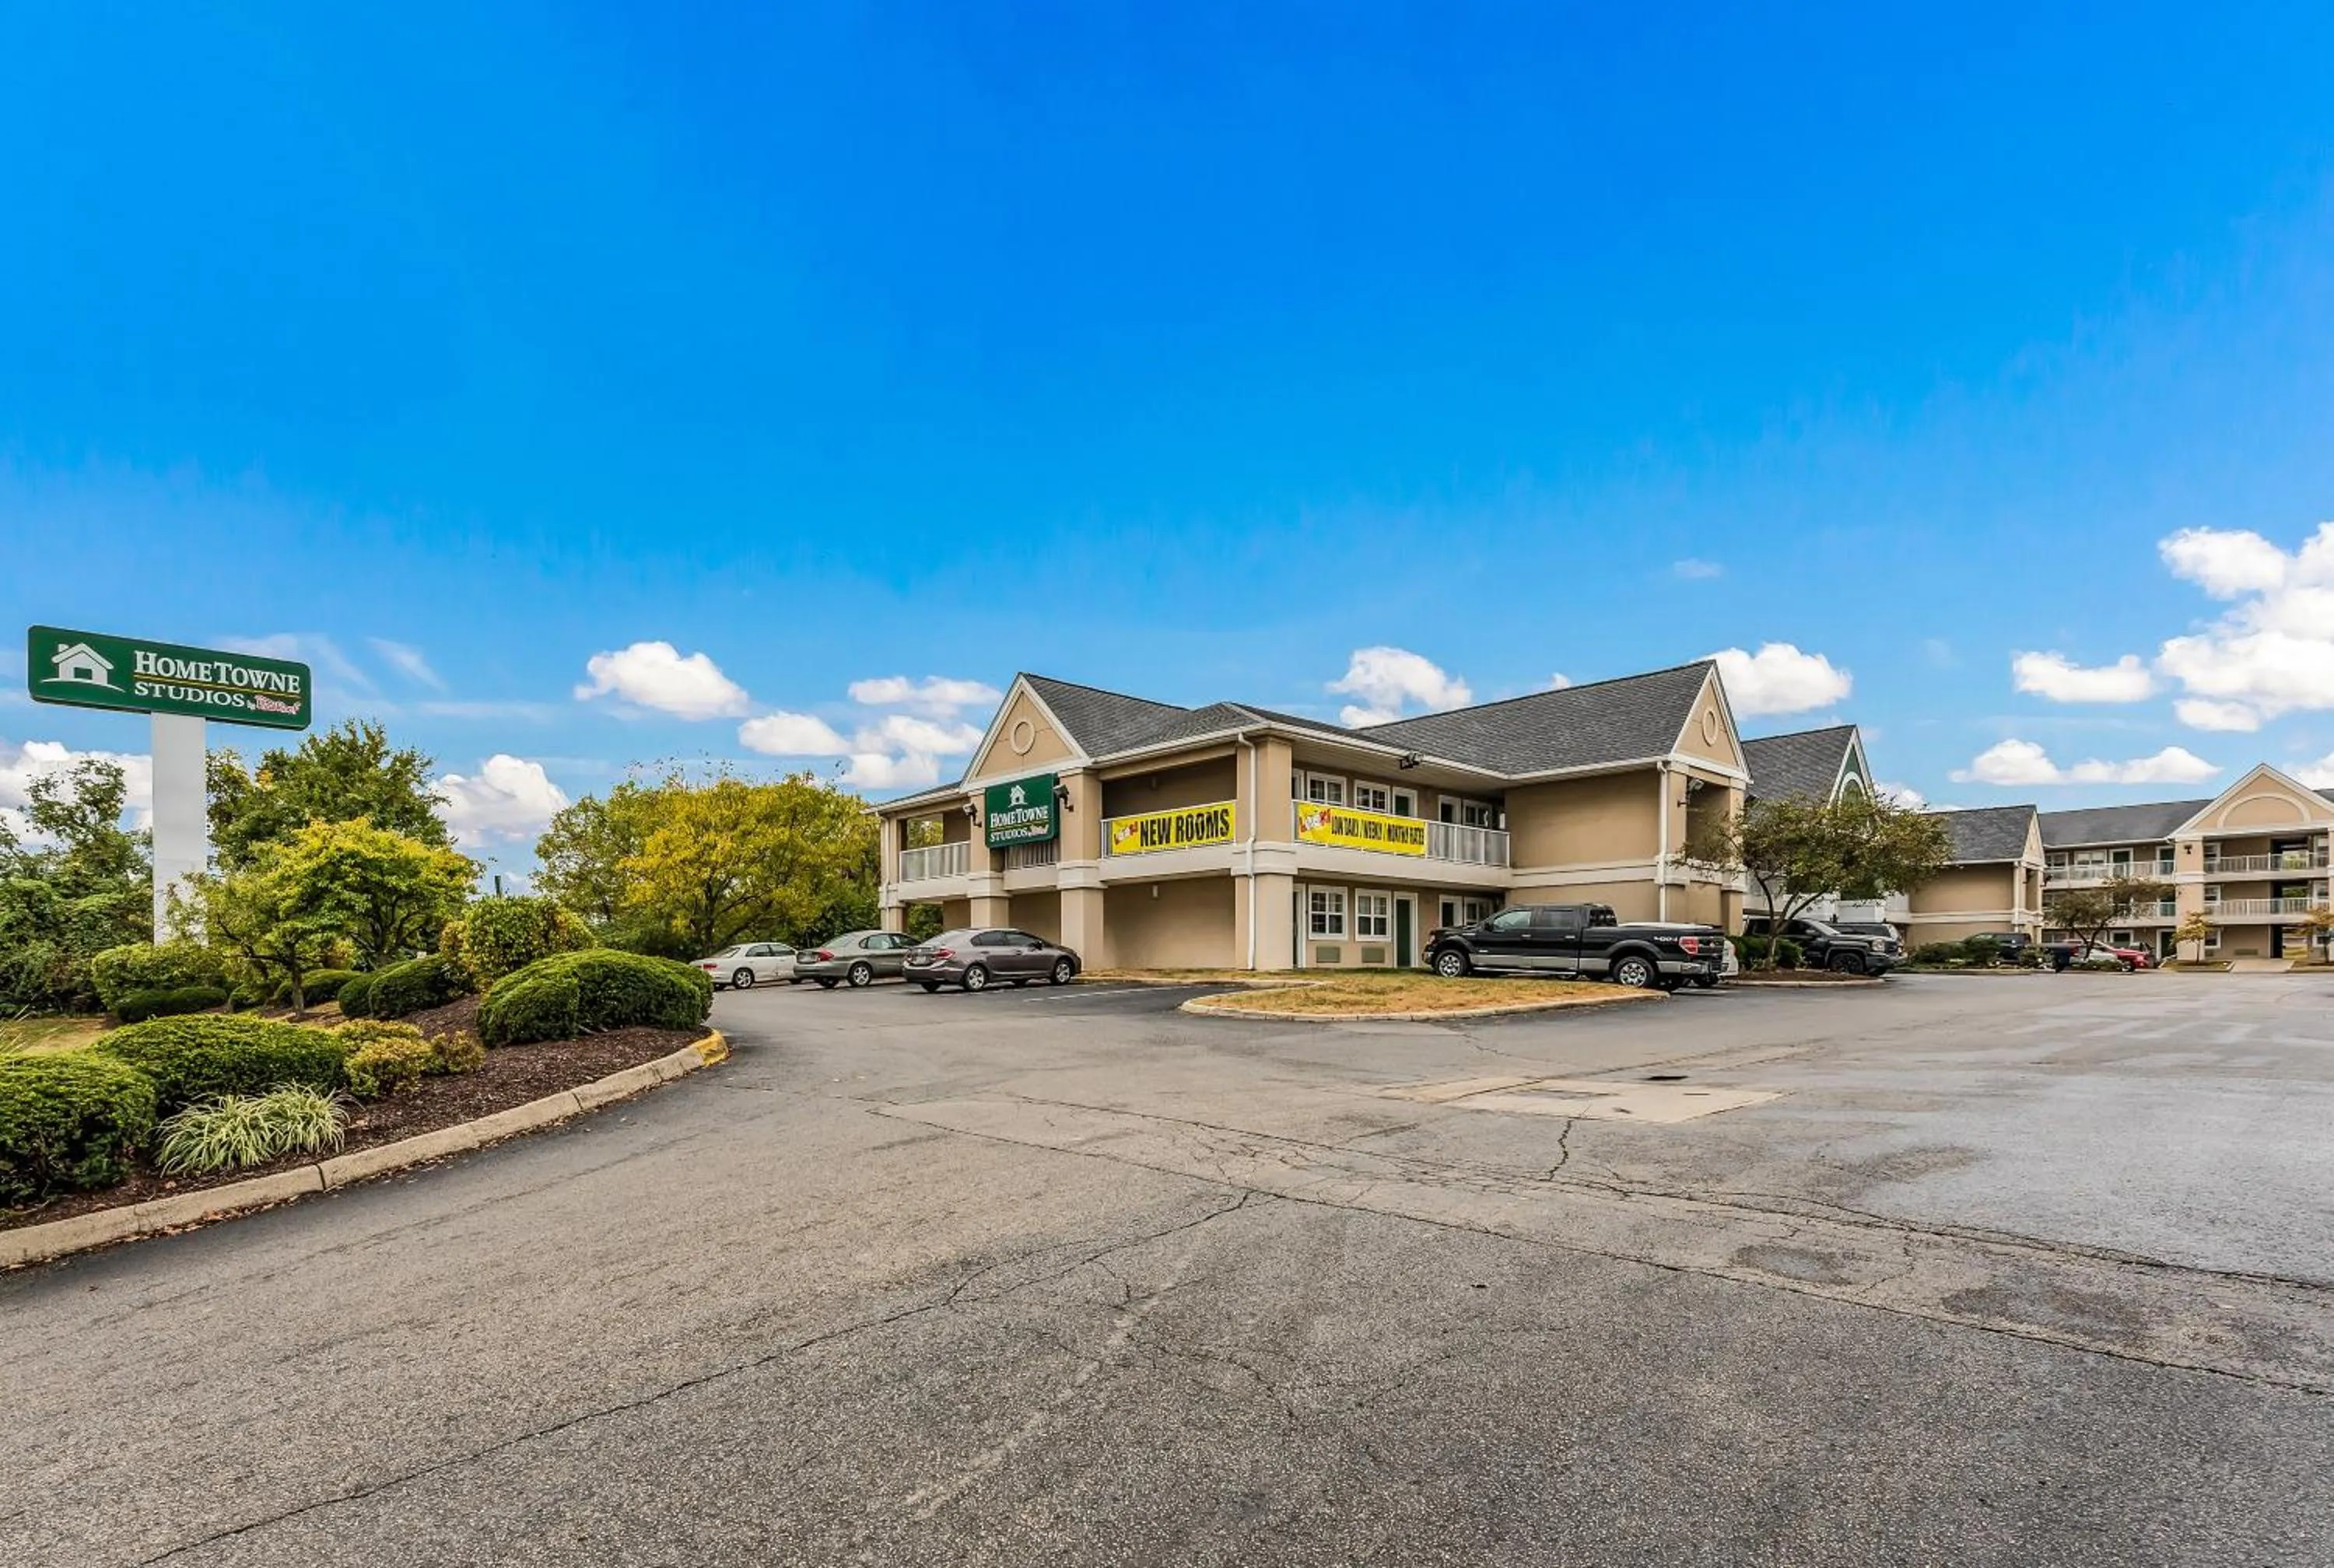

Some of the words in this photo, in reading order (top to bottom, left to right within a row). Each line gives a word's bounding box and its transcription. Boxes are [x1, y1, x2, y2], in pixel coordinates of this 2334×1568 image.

[135, 681, 245, 707] STUDIOS
[1140, 817, 1172, 847] NEW
[1176, 808, 1230, 844] ROOMS
